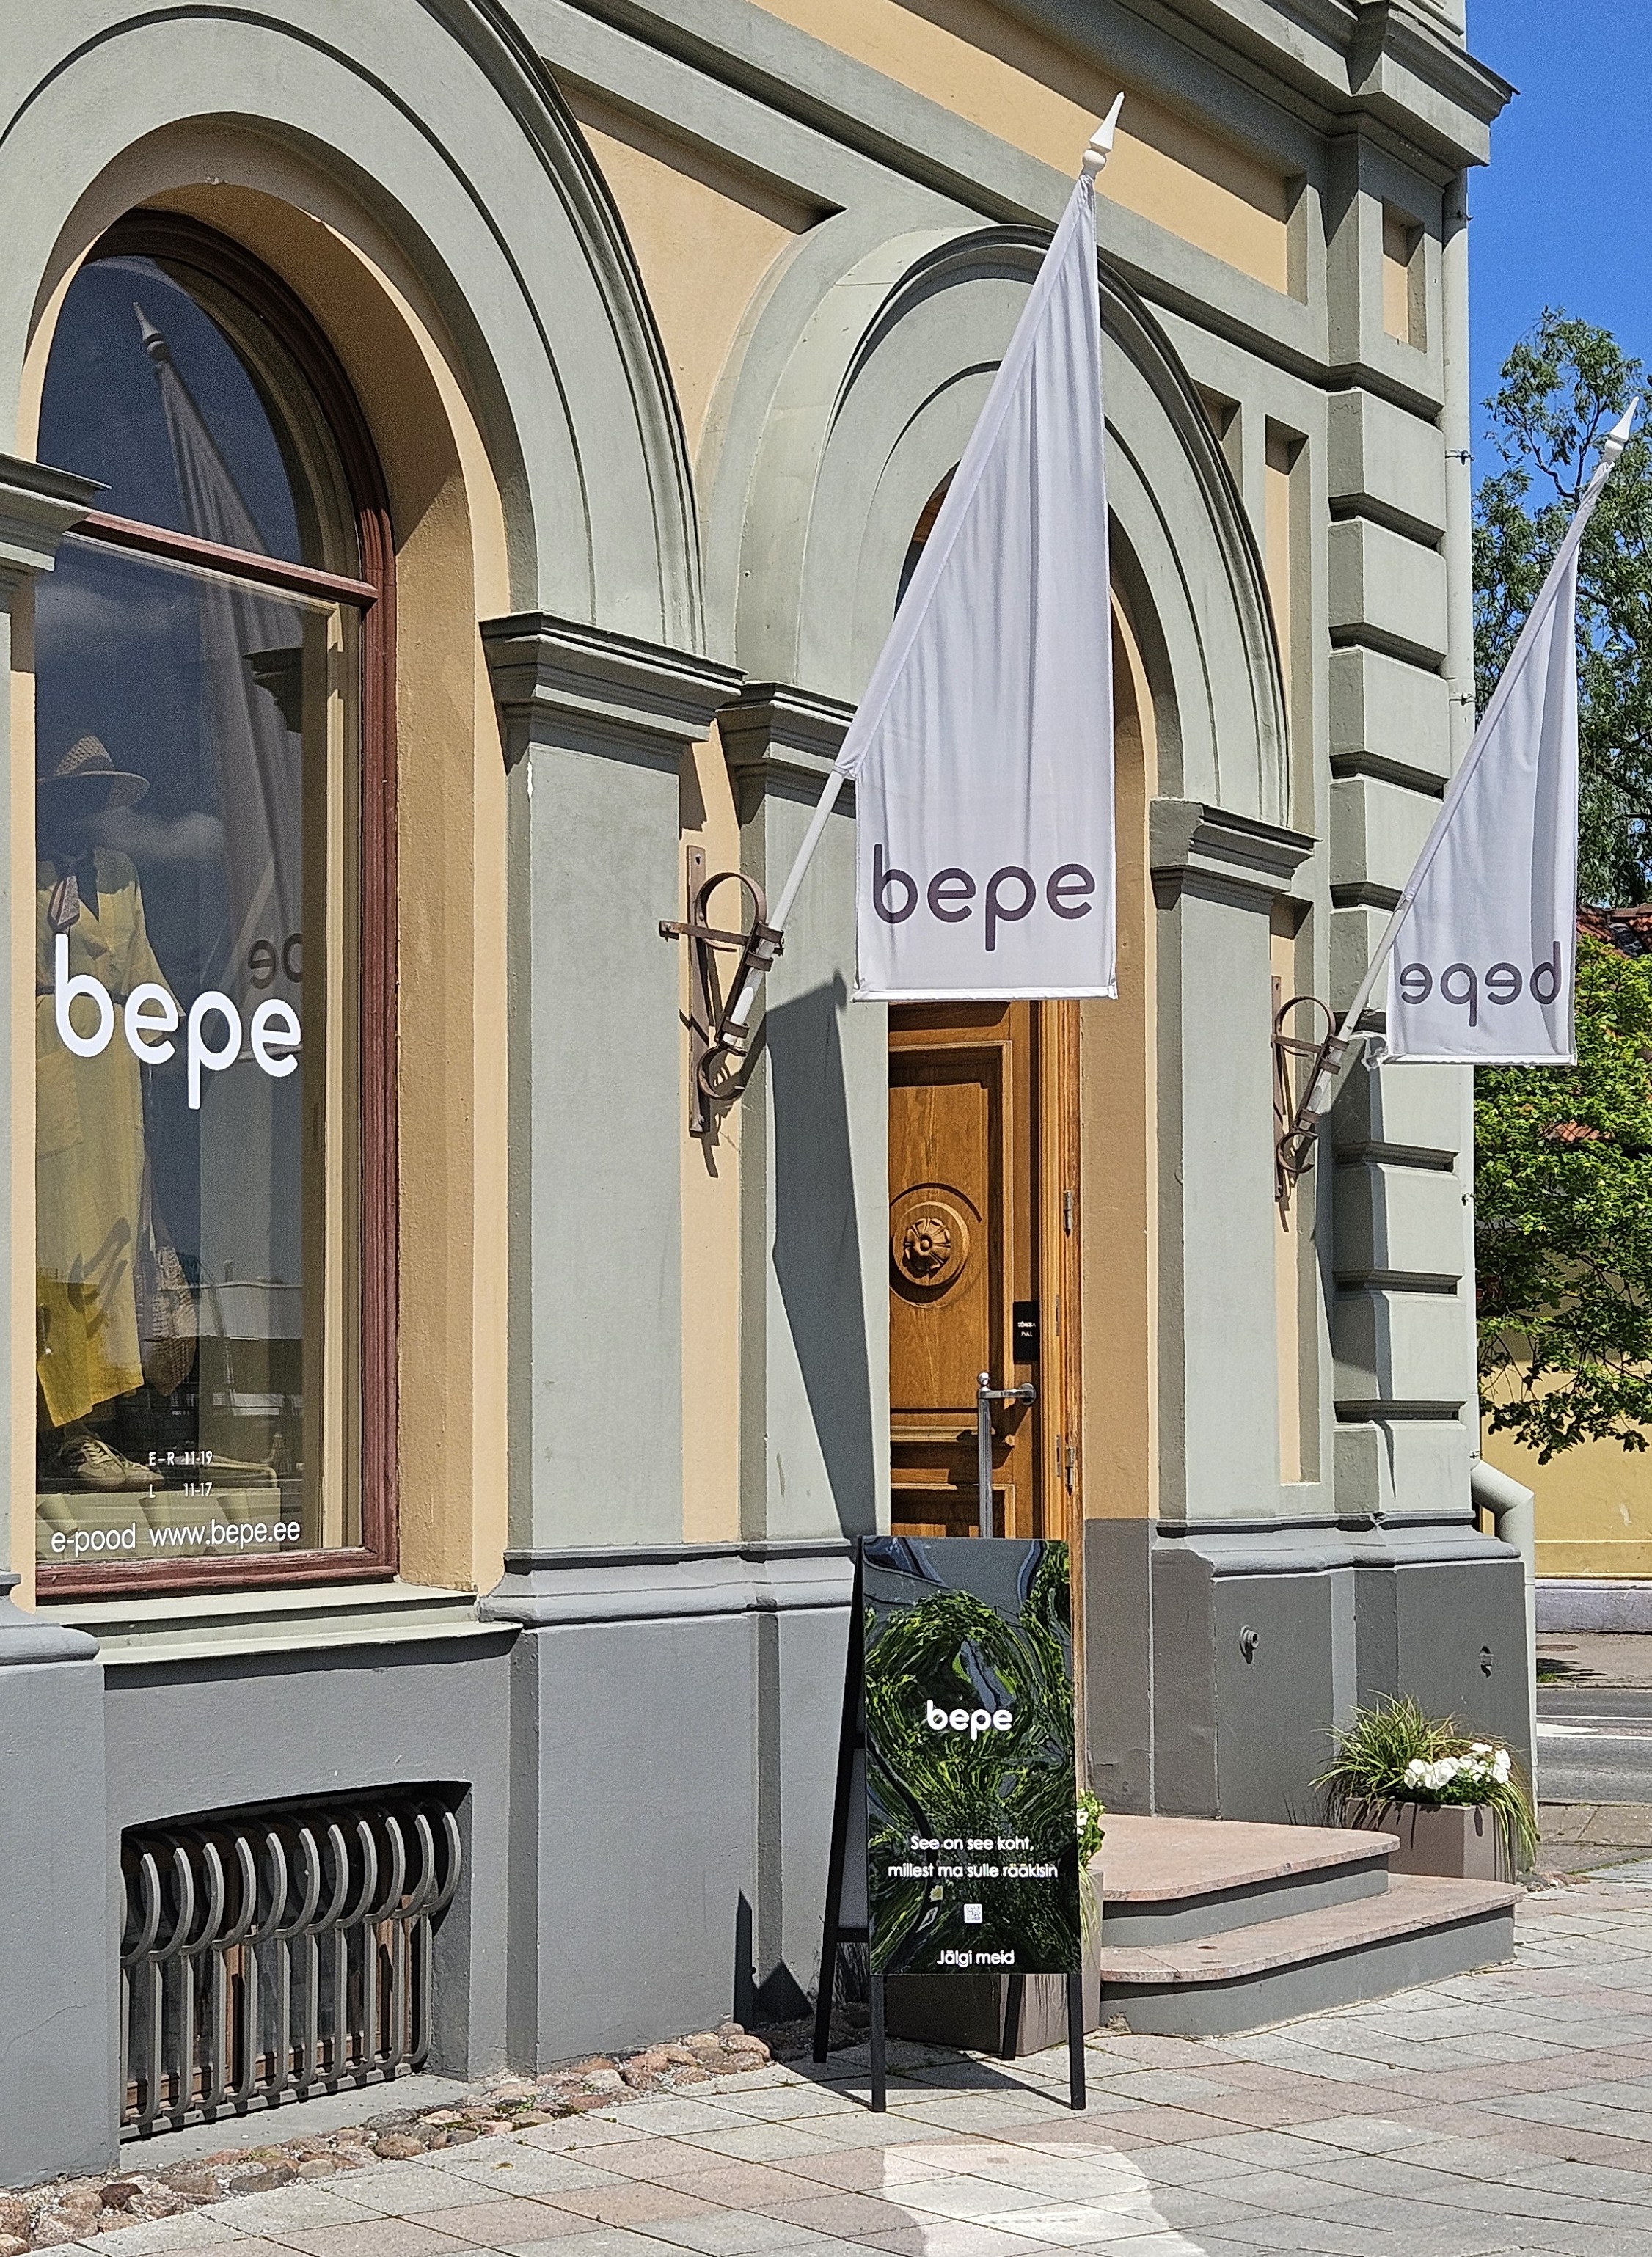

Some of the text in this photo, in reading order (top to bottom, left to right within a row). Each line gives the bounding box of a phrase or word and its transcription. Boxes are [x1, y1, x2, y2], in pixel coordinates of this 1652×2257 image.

[873, 844, 1096, 951] bepe
[55, 933, 301, 1110] bepe
[185, 1451, 213, 1466] 11-19
[149, 1482, 213, 1499] L 11-17
[51, 1519, 301, 1557] e-pood www.bepe.ee
[926, 1699, 1013, 1741] bepe
[910, 1835, 1034, 1852] See on see koht,
[888, 1863, 1058, 1878] millest ma sulle rääkisin
[936, 1949, 1015, 1968] Jälgi meid
